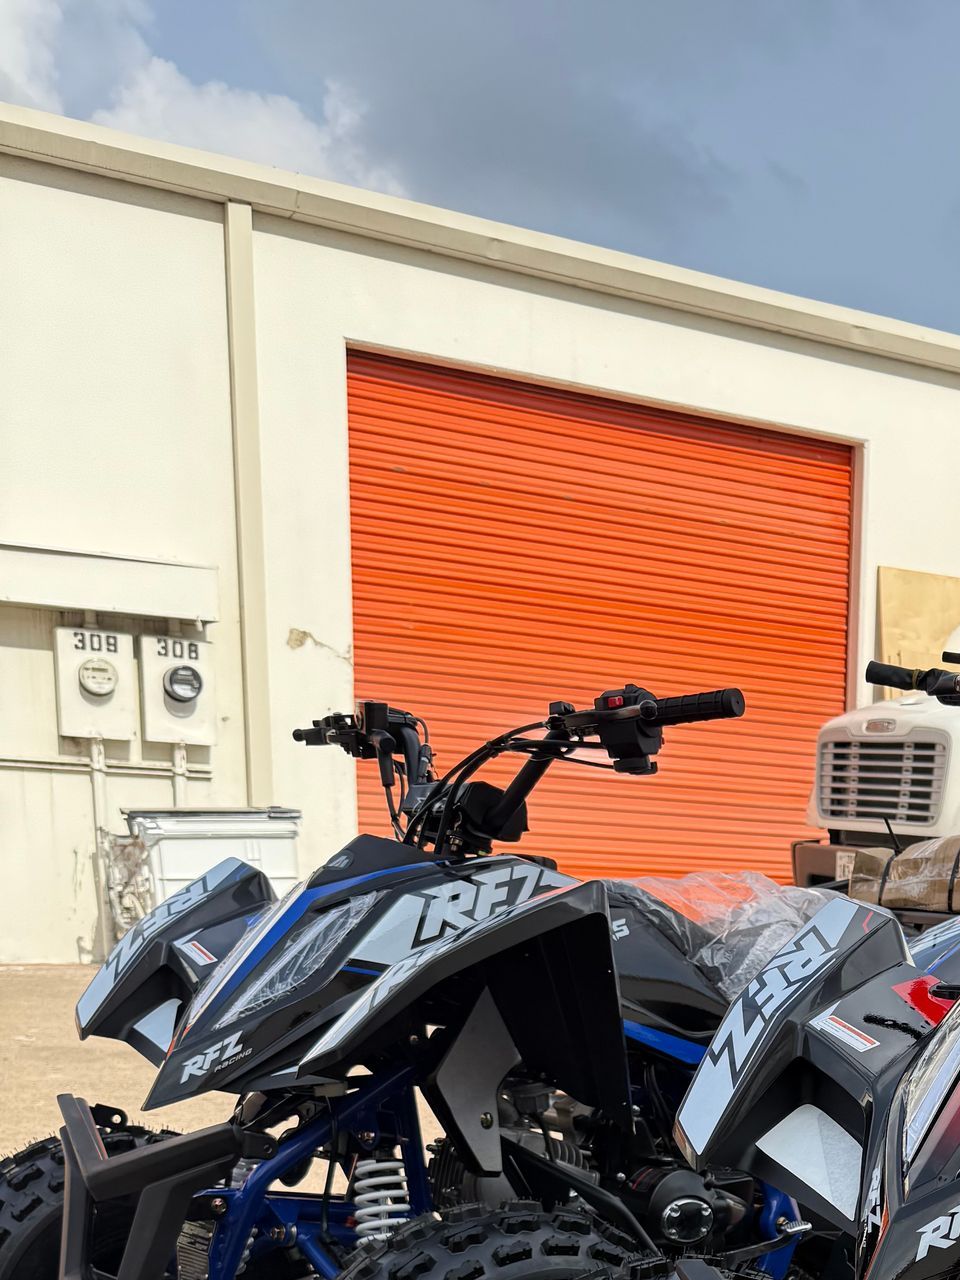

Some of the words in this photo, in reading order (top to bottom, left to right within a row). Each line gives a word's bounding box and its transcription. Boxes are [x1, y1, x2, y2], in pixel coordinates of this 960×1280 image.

[73, 632, 118, 653] 309
[157, 638, 199, 660] 308
[711, 928, 840, 1078] RFZ
[180, 1030, 243, 1084] RFZ
